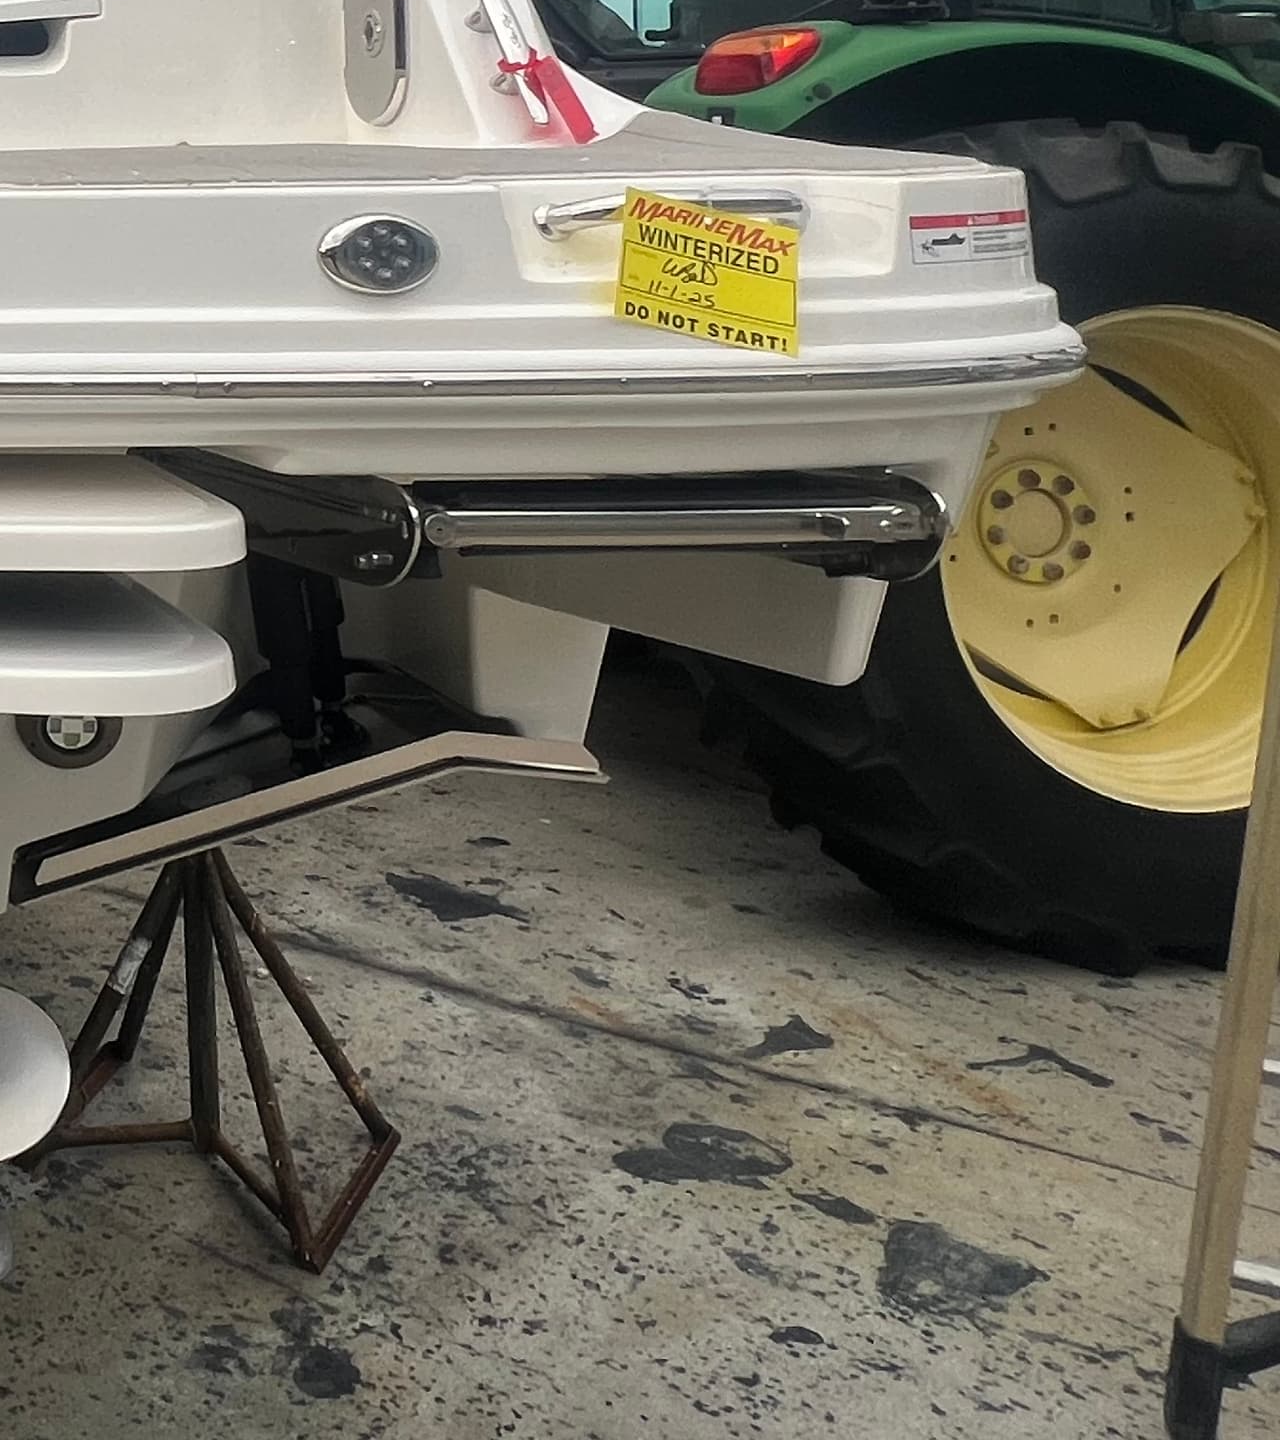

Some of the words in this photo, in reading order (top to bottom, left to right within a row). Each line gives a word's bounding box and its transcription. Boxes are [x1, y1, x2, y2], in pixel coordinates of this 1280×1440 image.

[639, 223, 779, 274] WINTERIZED
[648, 280, 716, 308] 11-1-25
[624, 301, 649, 320] DO
[657, 310, 699, 332] NOT
[707, 322, 788, 352] START!
